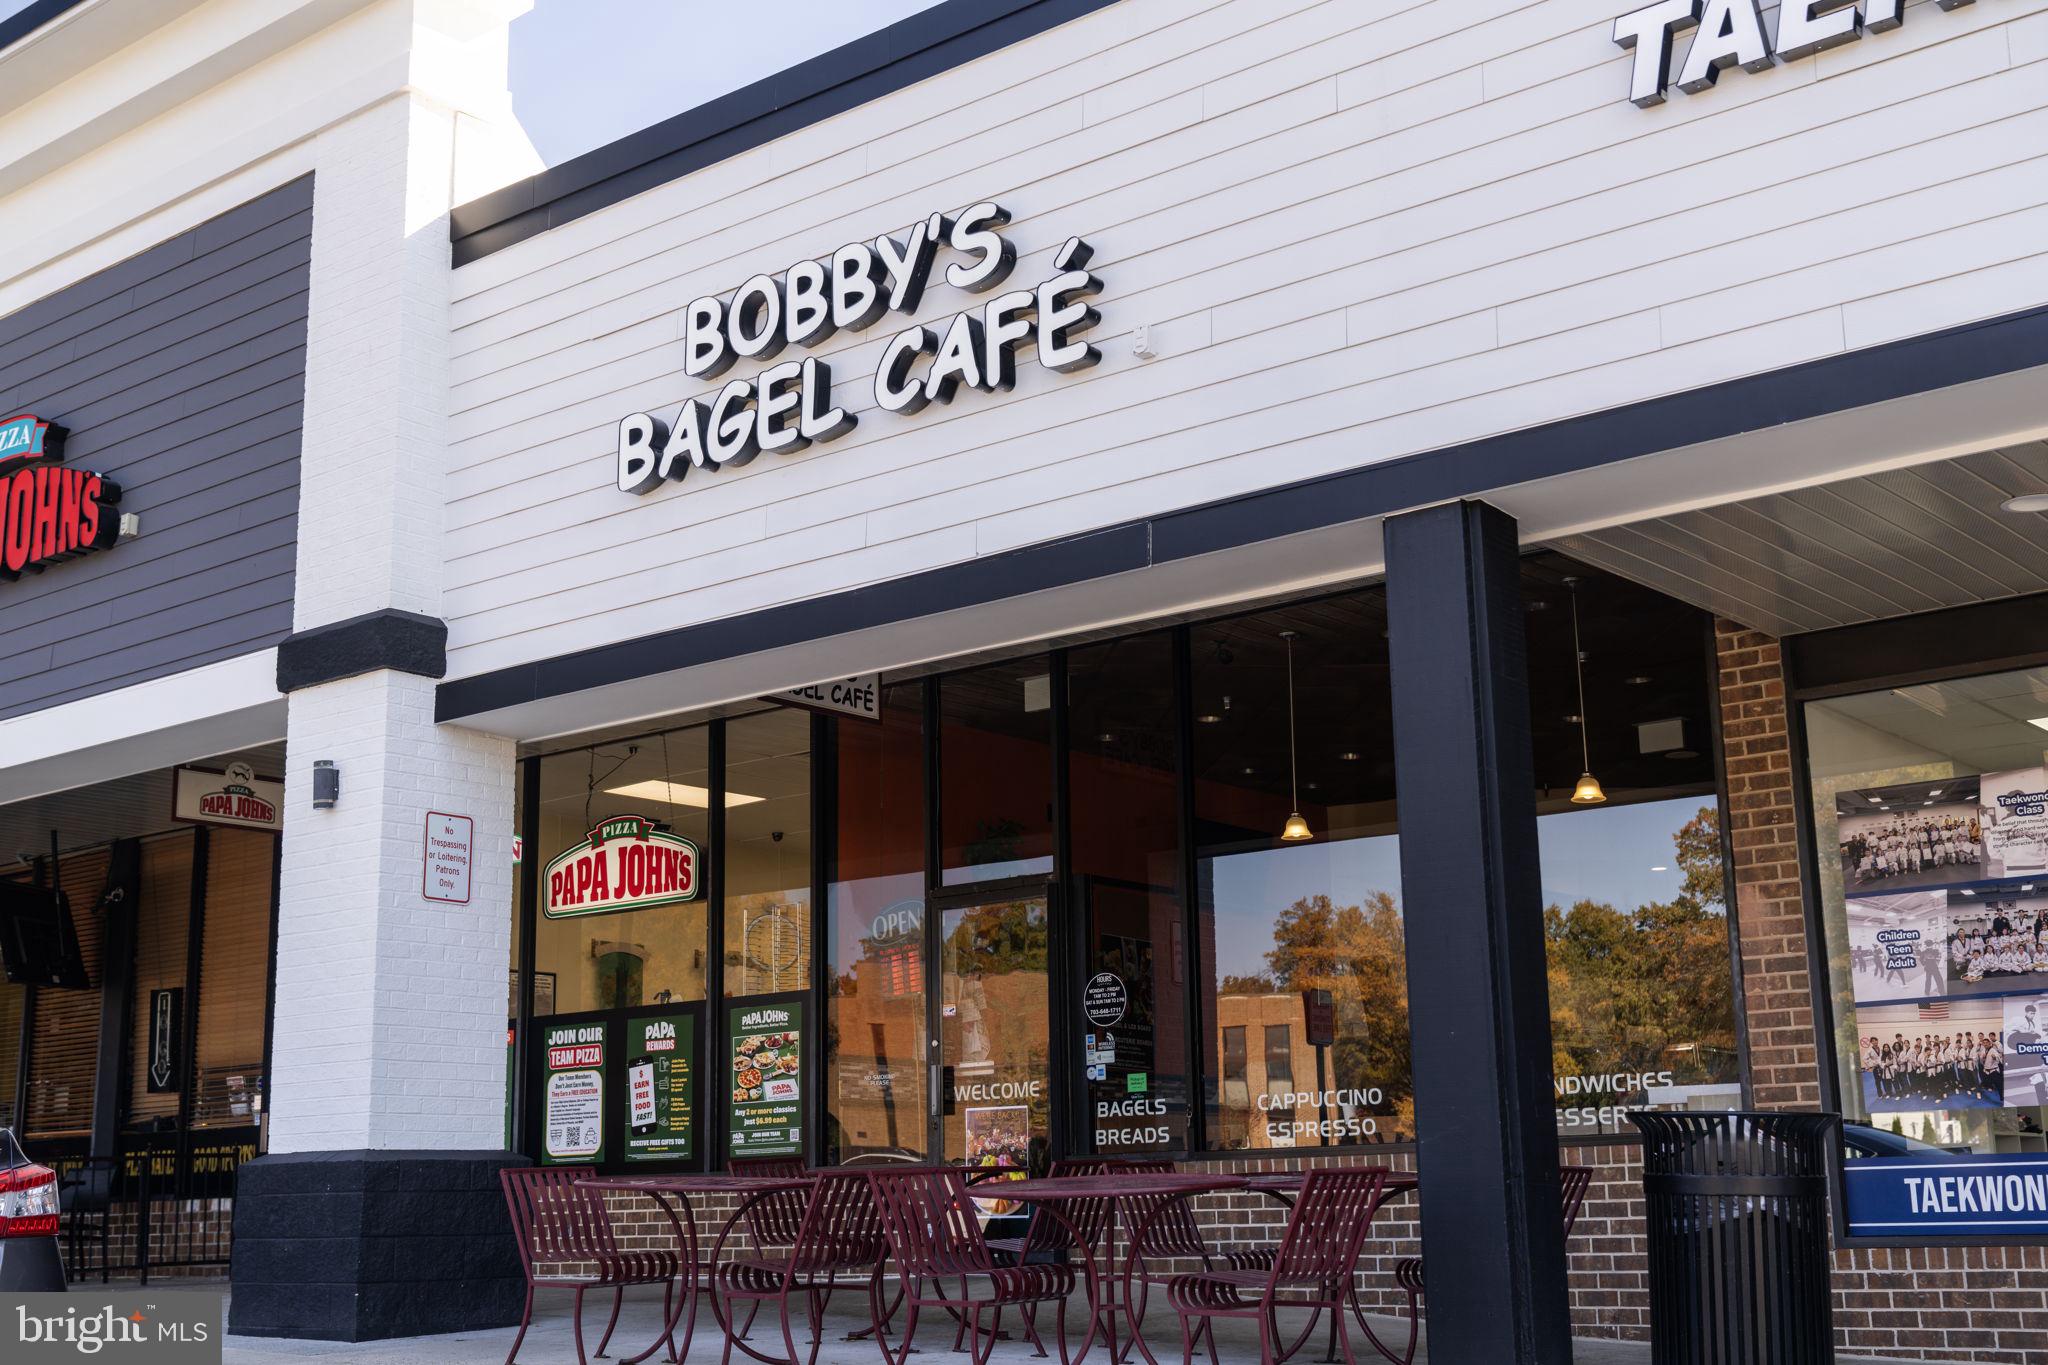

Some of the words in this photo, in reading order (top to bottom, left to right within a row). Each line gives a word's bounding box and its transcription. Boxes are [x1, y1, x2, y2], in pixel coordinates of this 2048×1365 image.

[684, 202, 1016, 381] BOBBY'S
[617, 357, 858, 496] BAGEL
[874, 236, 1104, 416] CAFÉ
[831, 684, 874, 712] CAFÉ
[202, 795, 233, 815] PAPA
[2016, 805, 2043, 815] Class
[445, 826, 454, 835] No
[602, 822, 638, 838] PIZZA
[431, 837, 467, 852] Trespassing
[429, 851, 436, 859] or
[436, 865, 460, 876] Patrons
[551, 850, 610, 907] PAPA
[614, 844, 692, 900] JOHN'S
[439, 879, 456, 890] Only.
[872, 907, 921, 941] OPEN
[1878, 931, 1919, 941] Children
[1888, 946, 1911, 954] Teen
[1888, 958, 1915, 968] Adult
[742, 1012, 761, 1025] PAPA
[548, 1029, 577, 1045] JOIN
[578, 1027, 603, 1043] OUR
[645, 1022, 675, 1039] PAPA
[646, 1040, 675, 1051] REWARDS
[551, 1049, 575, 1066] TEAM
[576, 1047, 600, 1064] PIZZA
[639, 1070, 643, 1078] $
[634, 1080, 649, 1089] EARN
[954, 1081, 1040, 1102] WELCOME
[635, 1091, 649, 1100] FREE
[1257, 1088, 1382, 1110] CAPPUCCINO
[635, 1102, 651, 1110] FOOD
[1097, 1098, 1167, 1117] BAGELS
[636, 1112, 652, 1121] FAST!
[744, 1118, 756, 1126] just
[1266, 1118, 1376, 1138] ESPRESSO
[1095, 1127, 1170, 1146] BREADS
[1903, 1174, 2048, 1214] TAEKWON
